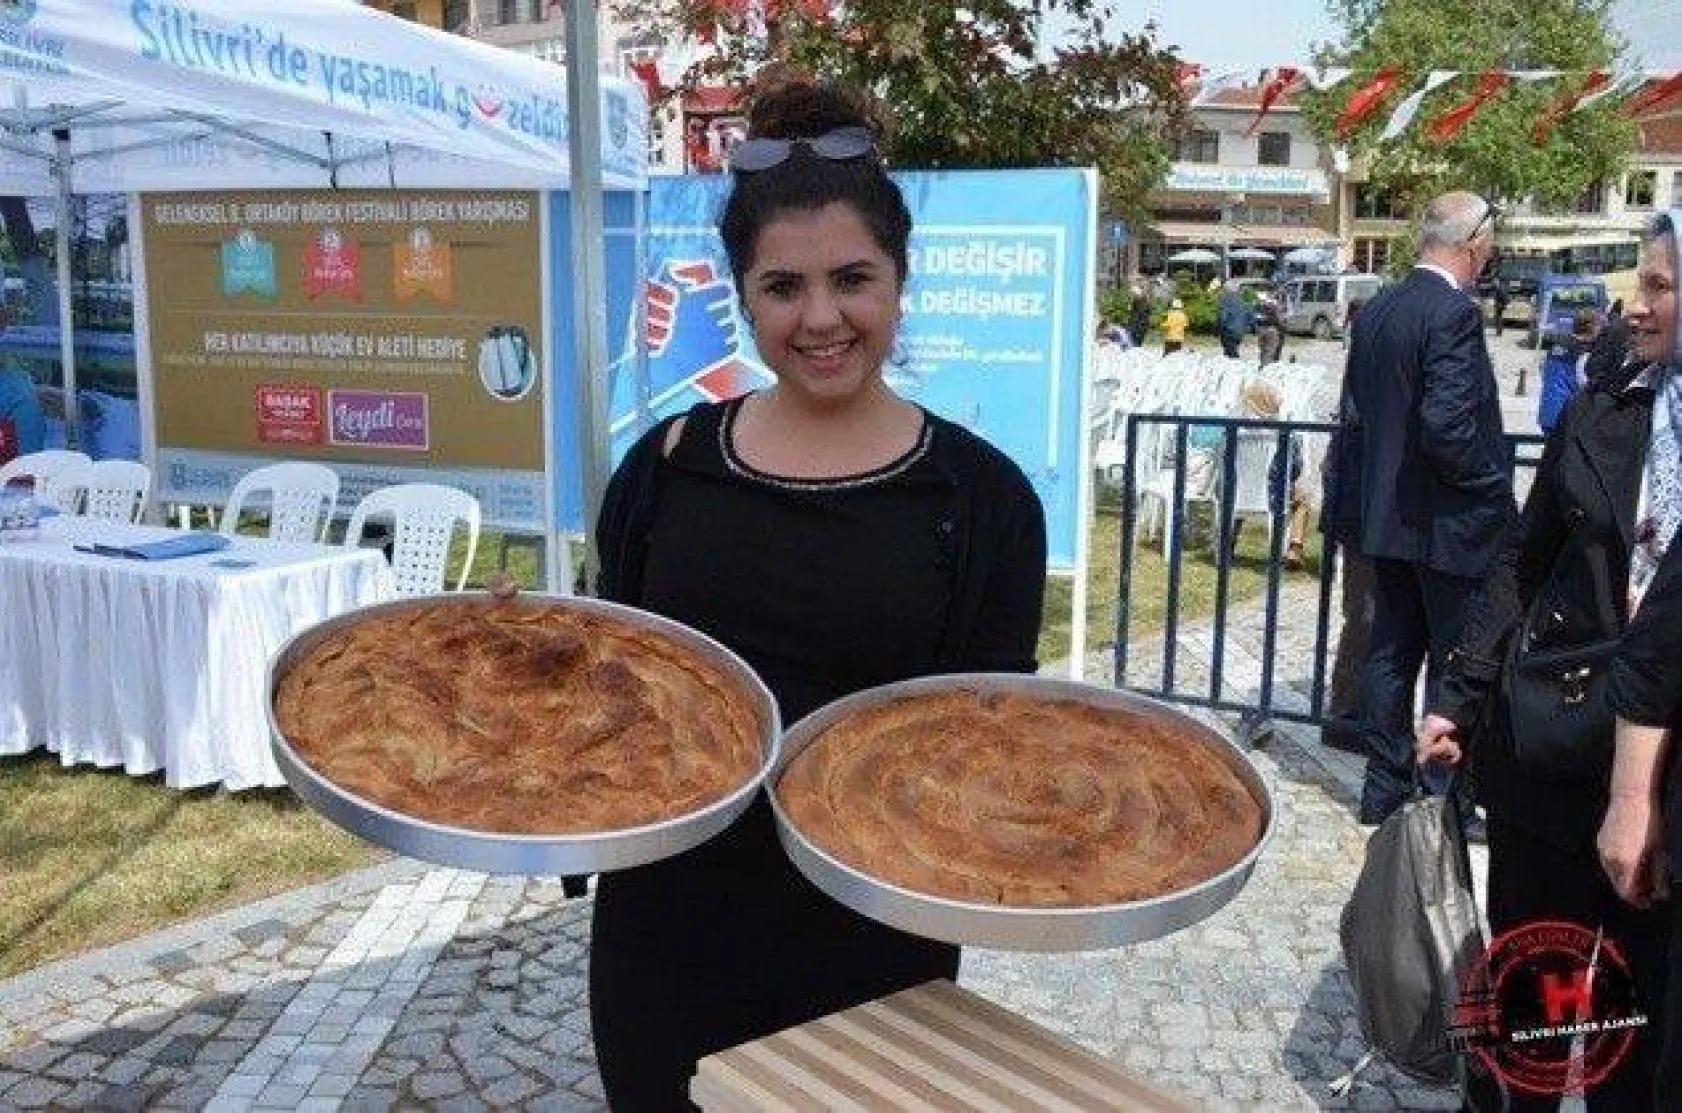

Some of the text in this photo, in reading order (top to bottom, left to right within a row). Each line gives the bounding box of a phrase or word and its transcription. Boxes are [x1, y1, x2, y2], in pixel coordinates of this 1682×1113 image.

[131, 0, 307, 86] Silivri'de
[319, 54, 447, 112] yaşamak
[923, 240, 1048, 284] DEĞİŞİR
[920, 286, 1047, 320] DEĞİŞMEZ
